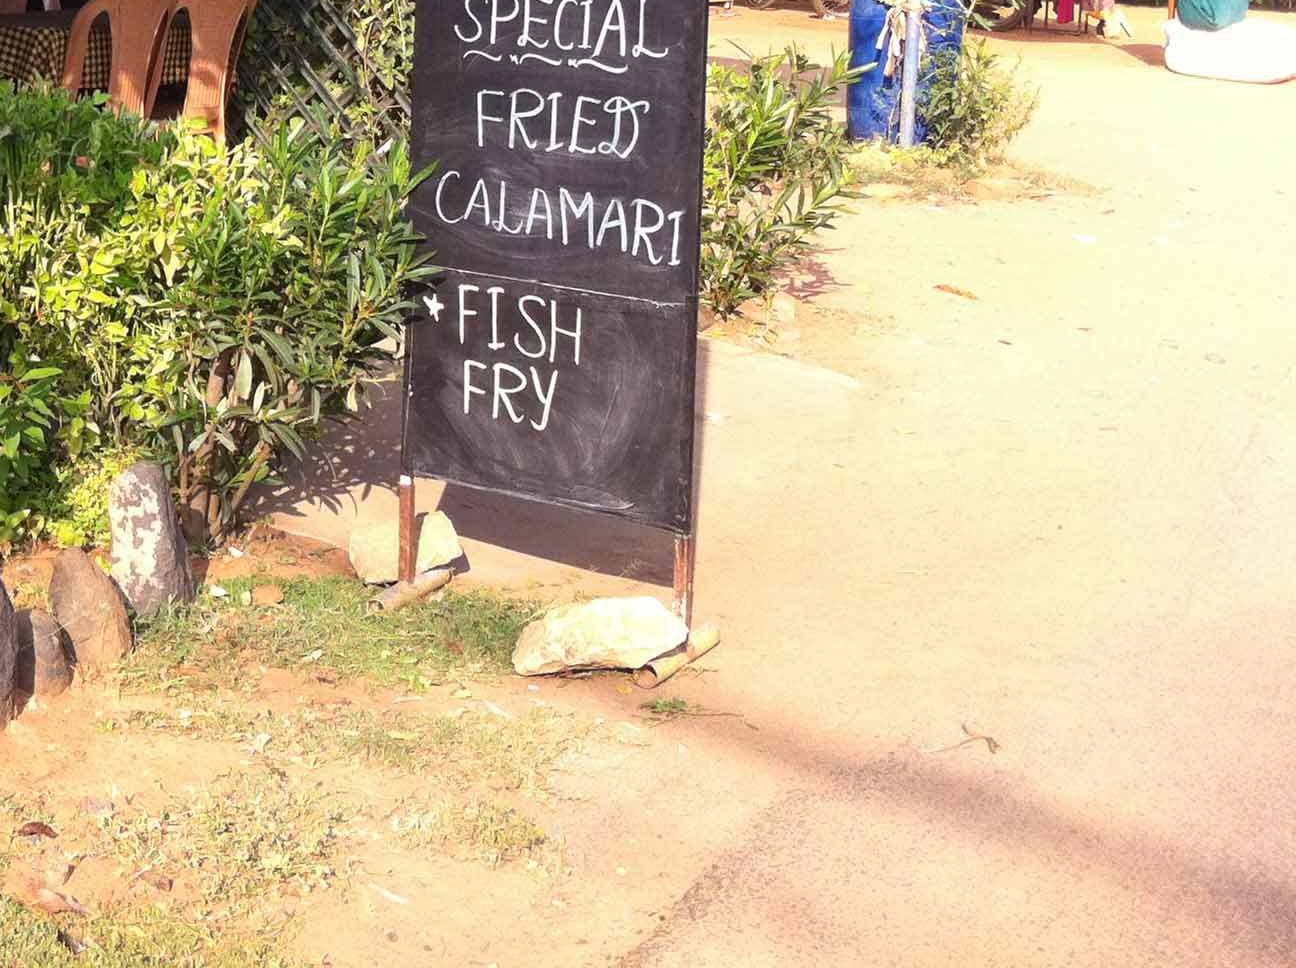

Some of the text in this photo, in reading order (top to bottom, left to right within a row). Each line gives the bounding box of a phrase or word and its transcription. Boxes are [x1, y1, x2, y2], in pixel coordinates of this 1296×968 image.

[476, 87, 650, 160] FRIED
[435, 170, 687, 267] CALAMARI
[456, 283, 583, 365] FISH
[462, 358, 559, 432] FRY
